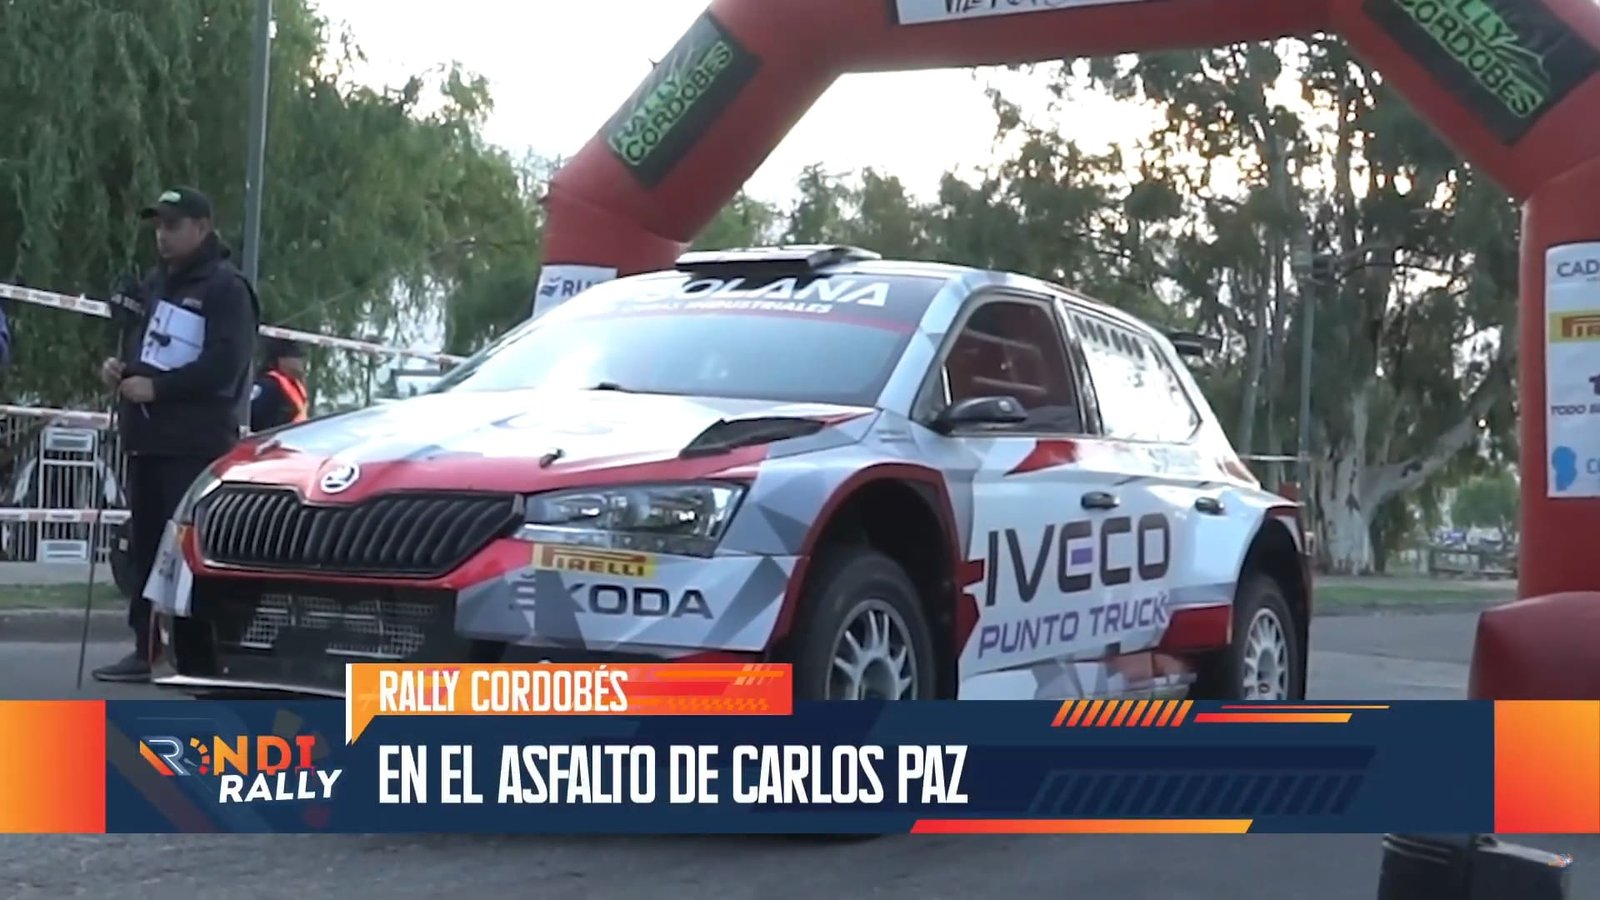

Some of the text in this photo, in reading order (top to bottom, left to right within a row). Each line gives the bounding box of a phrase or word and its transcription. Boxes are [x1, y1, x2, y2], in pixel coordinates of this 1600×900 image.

[1402, 0, 1541, 116] ORDOBES
[541, 546, 647, 577] PIRELLI
[985, 512, 1171, 608] IVECO
[509, 573, 715, 619] ŠKODA
[977, 593, 1167, 659] PUNTO TRUCK
